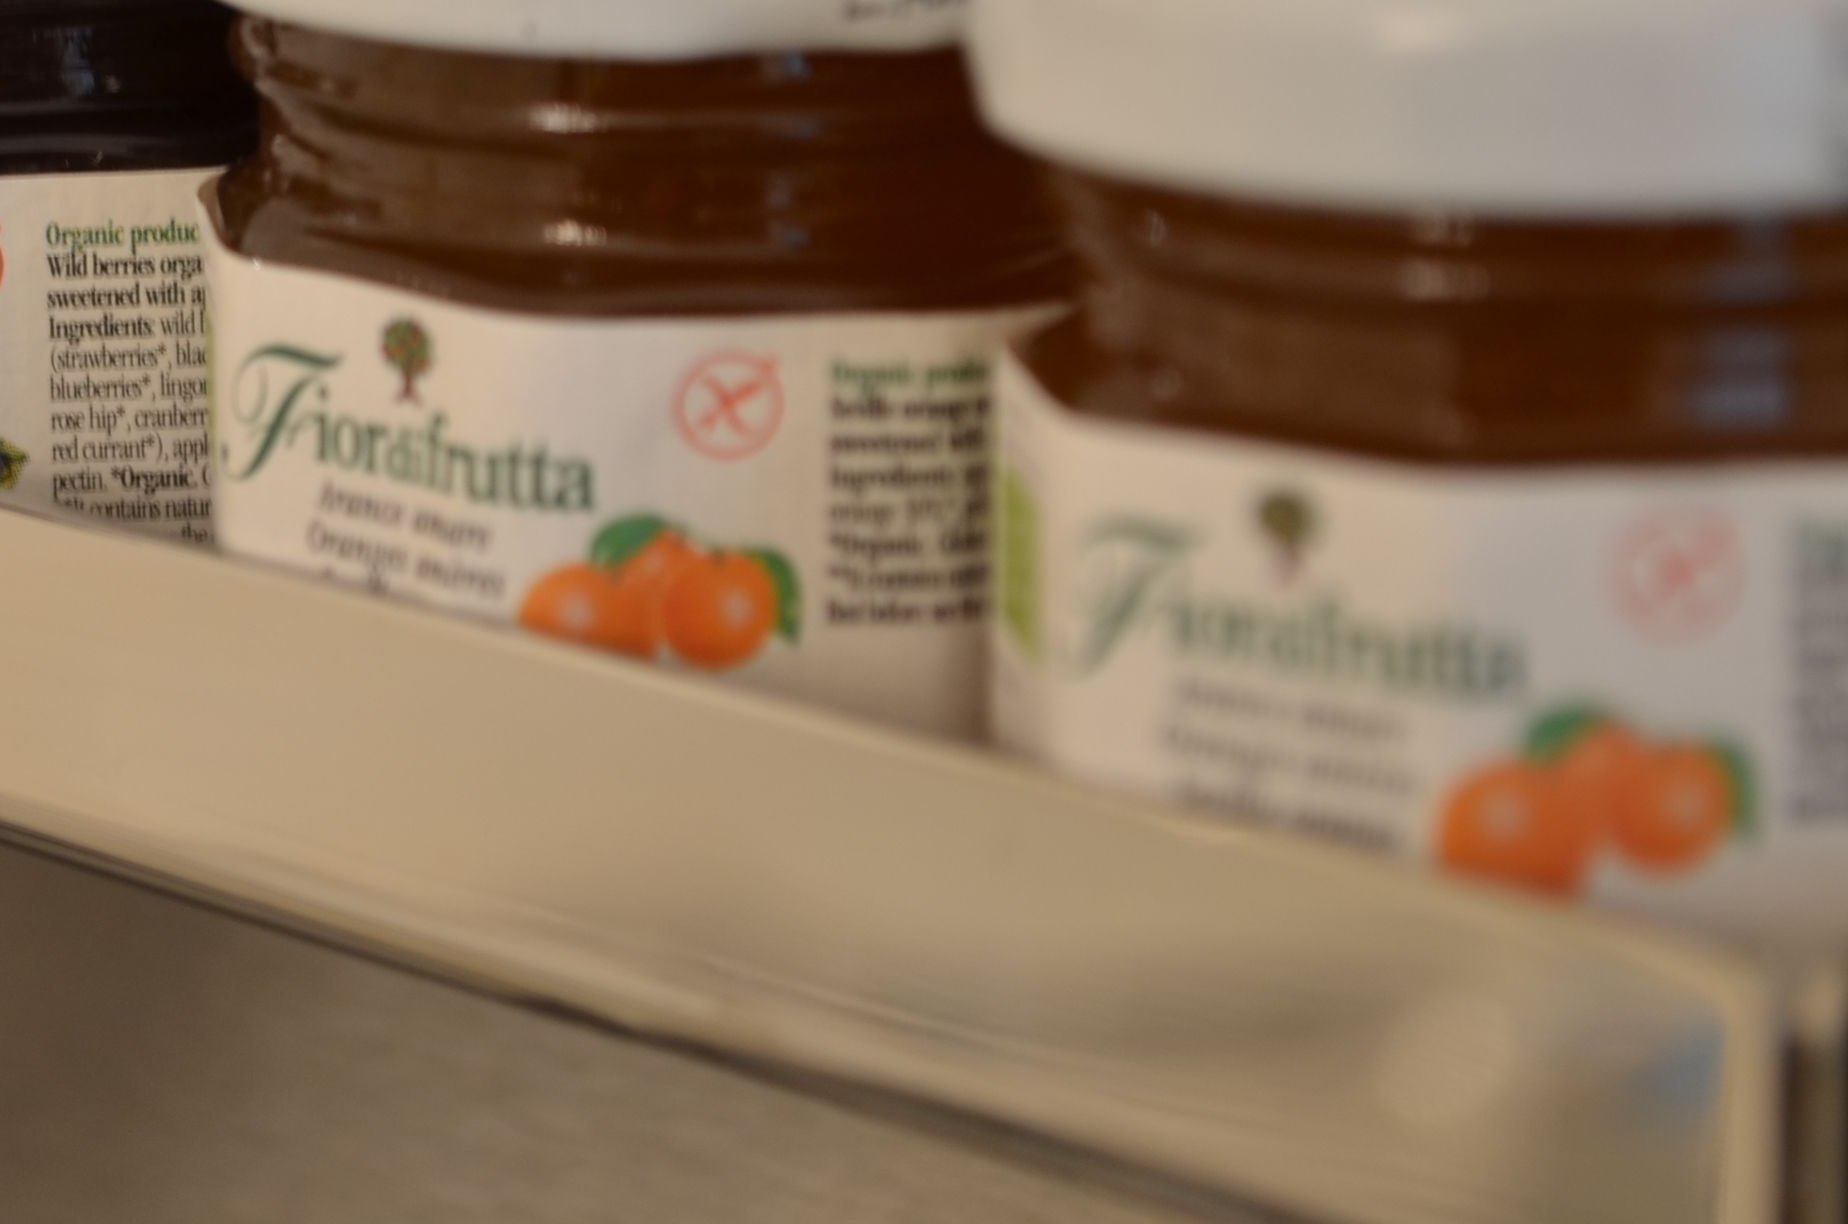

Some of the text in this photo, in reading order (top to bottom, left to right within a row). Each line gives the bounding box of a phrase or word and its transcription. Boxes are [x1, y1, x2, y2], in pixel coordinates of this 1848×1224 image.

[45, 218, 124, 254] Organic
[47, 252, 88, 278] Wild
[92, 250, 156, 276] berries
[47, 280, 141, 308] sweetened
[145, 279, 186, 306] with
[159, 309, 196, 336] wild
[51, 408, 86, 431] rose
[217, 343, 595, 512] Fiordifrutta
[52, 434, 79, 462] red
